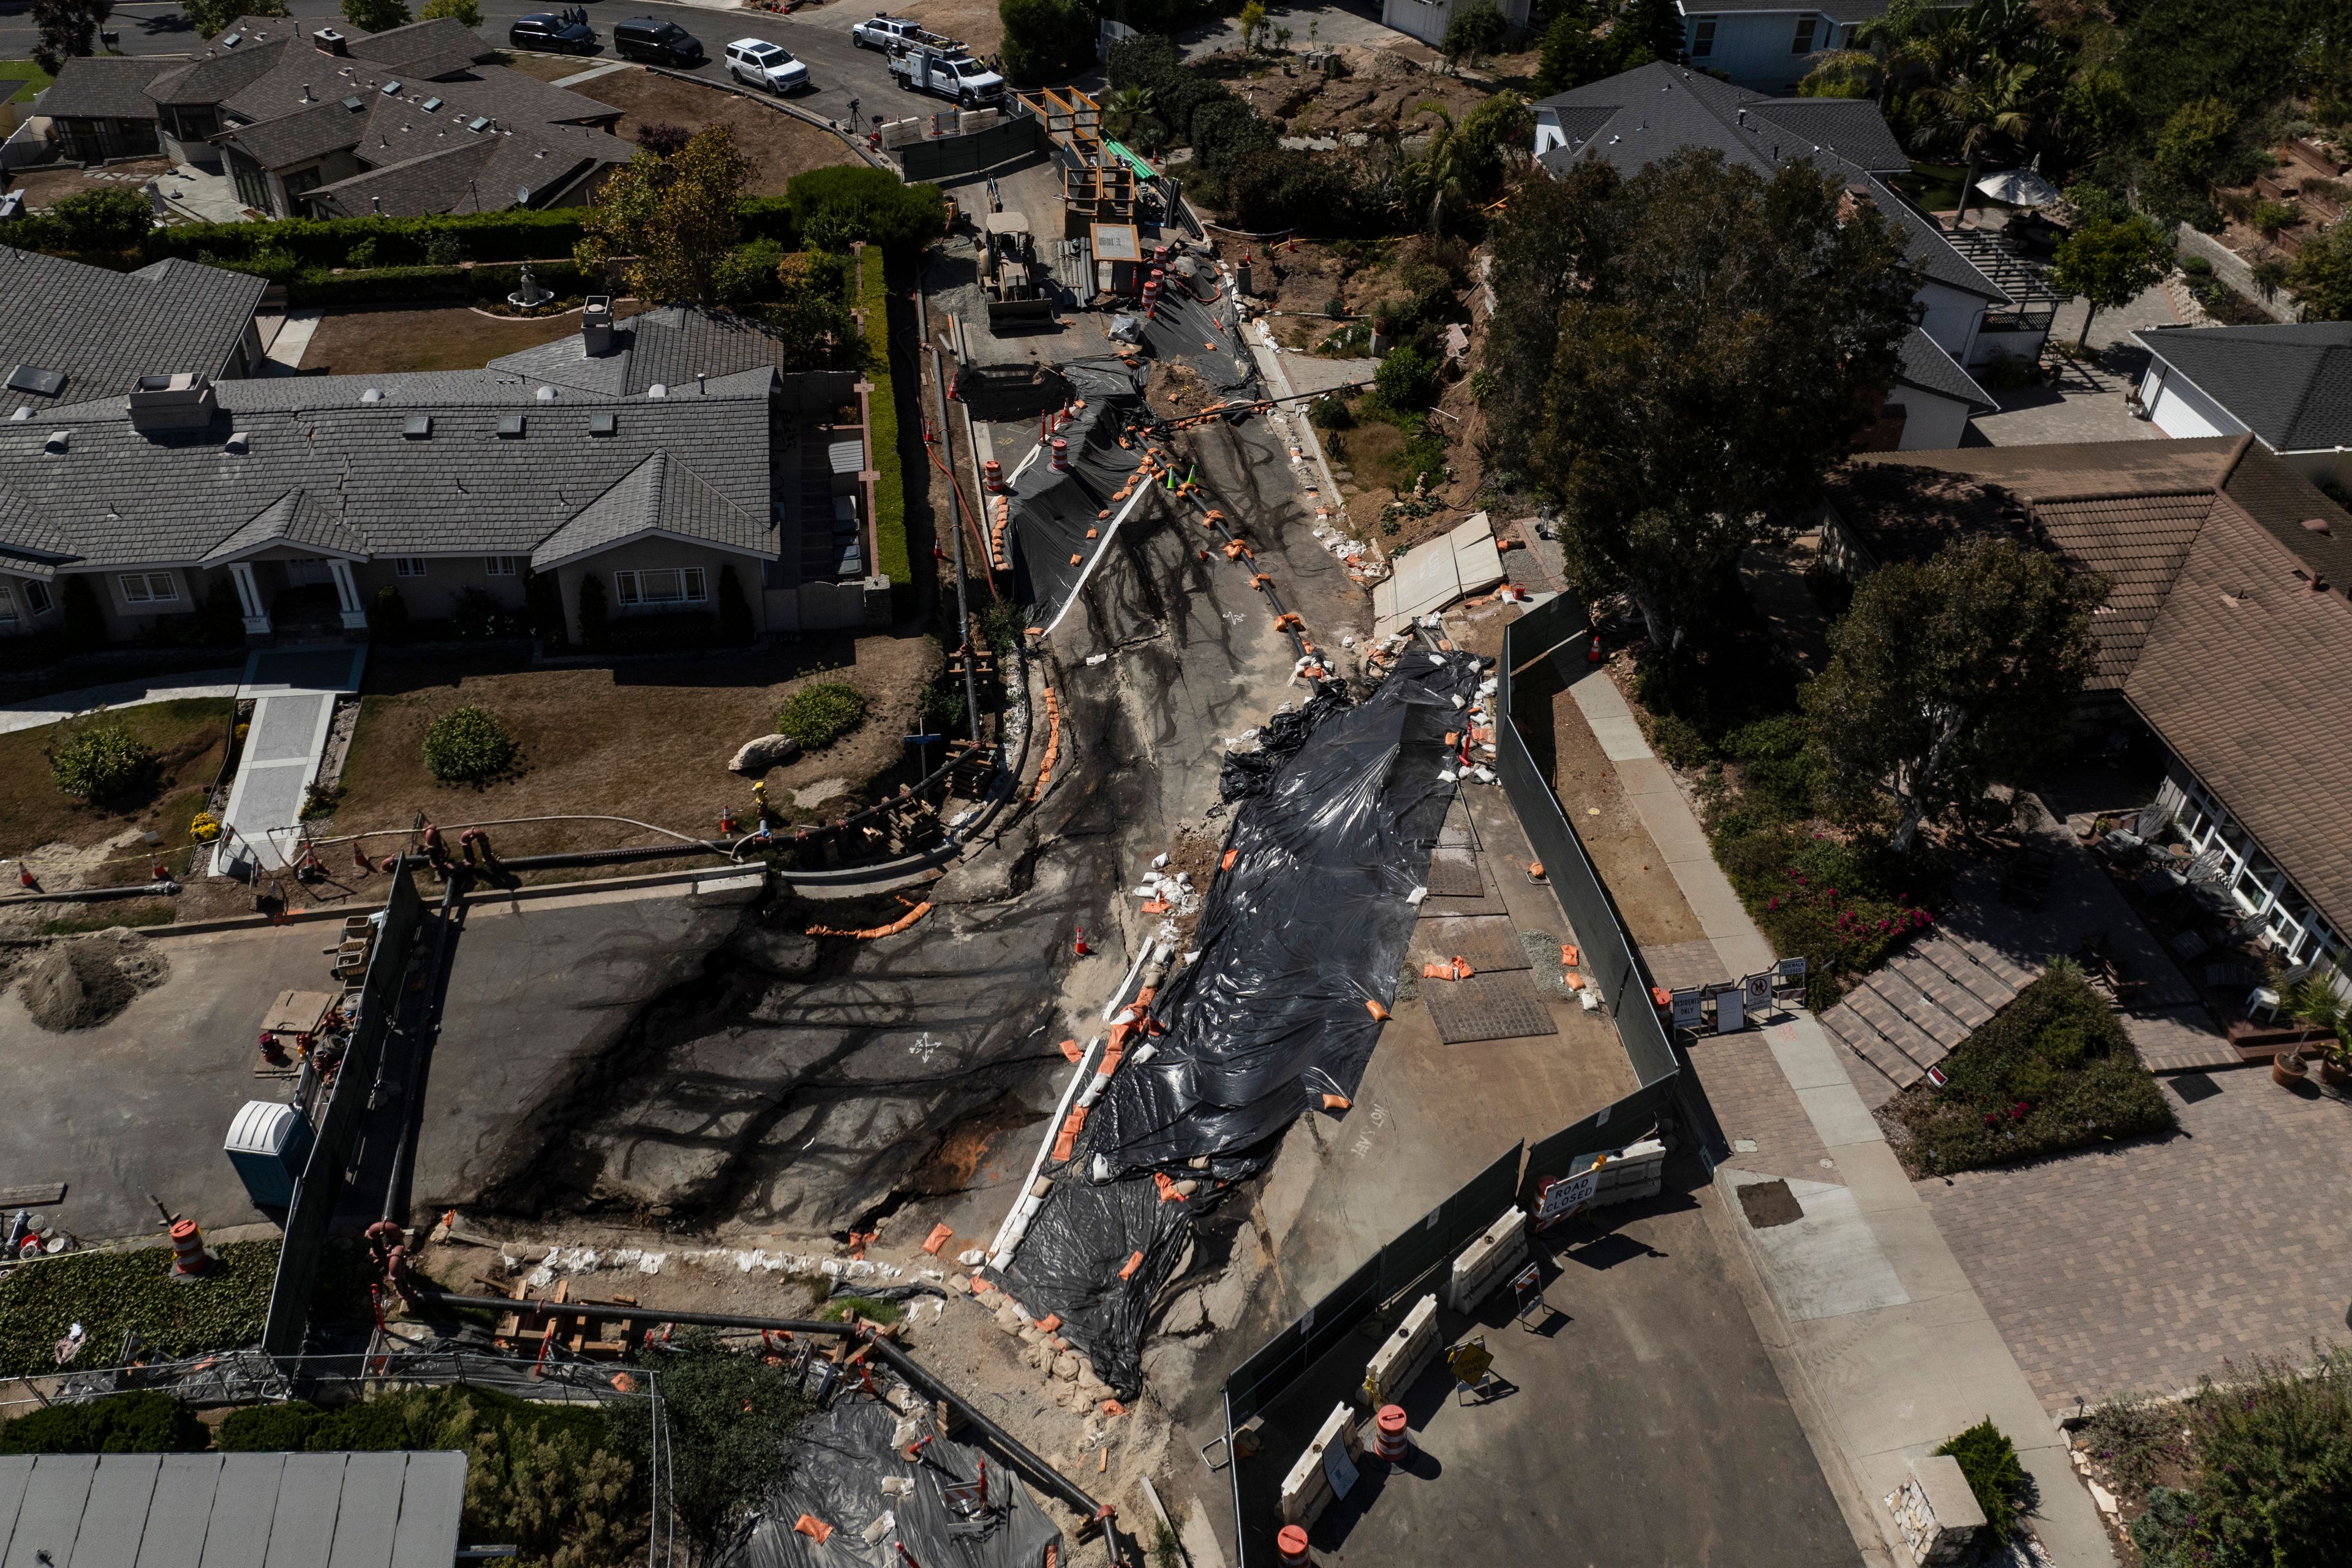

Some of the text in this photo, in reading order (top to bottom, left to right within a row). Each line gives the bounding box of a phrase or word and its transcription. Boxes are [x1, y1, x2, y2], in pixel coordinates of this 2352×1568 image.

[1674, 997, 1700, 1007] RESIDENTS
[1371, 1104, 1387, 1128] NOT
[1555, 1178, 1589, 1199] ROAD
[1546, 1187, 1593, 1213] CLOSED
[1460, 1355, 1484, 1368] ROUGH
[1463, 1365, 1483, 1376] ROAD
